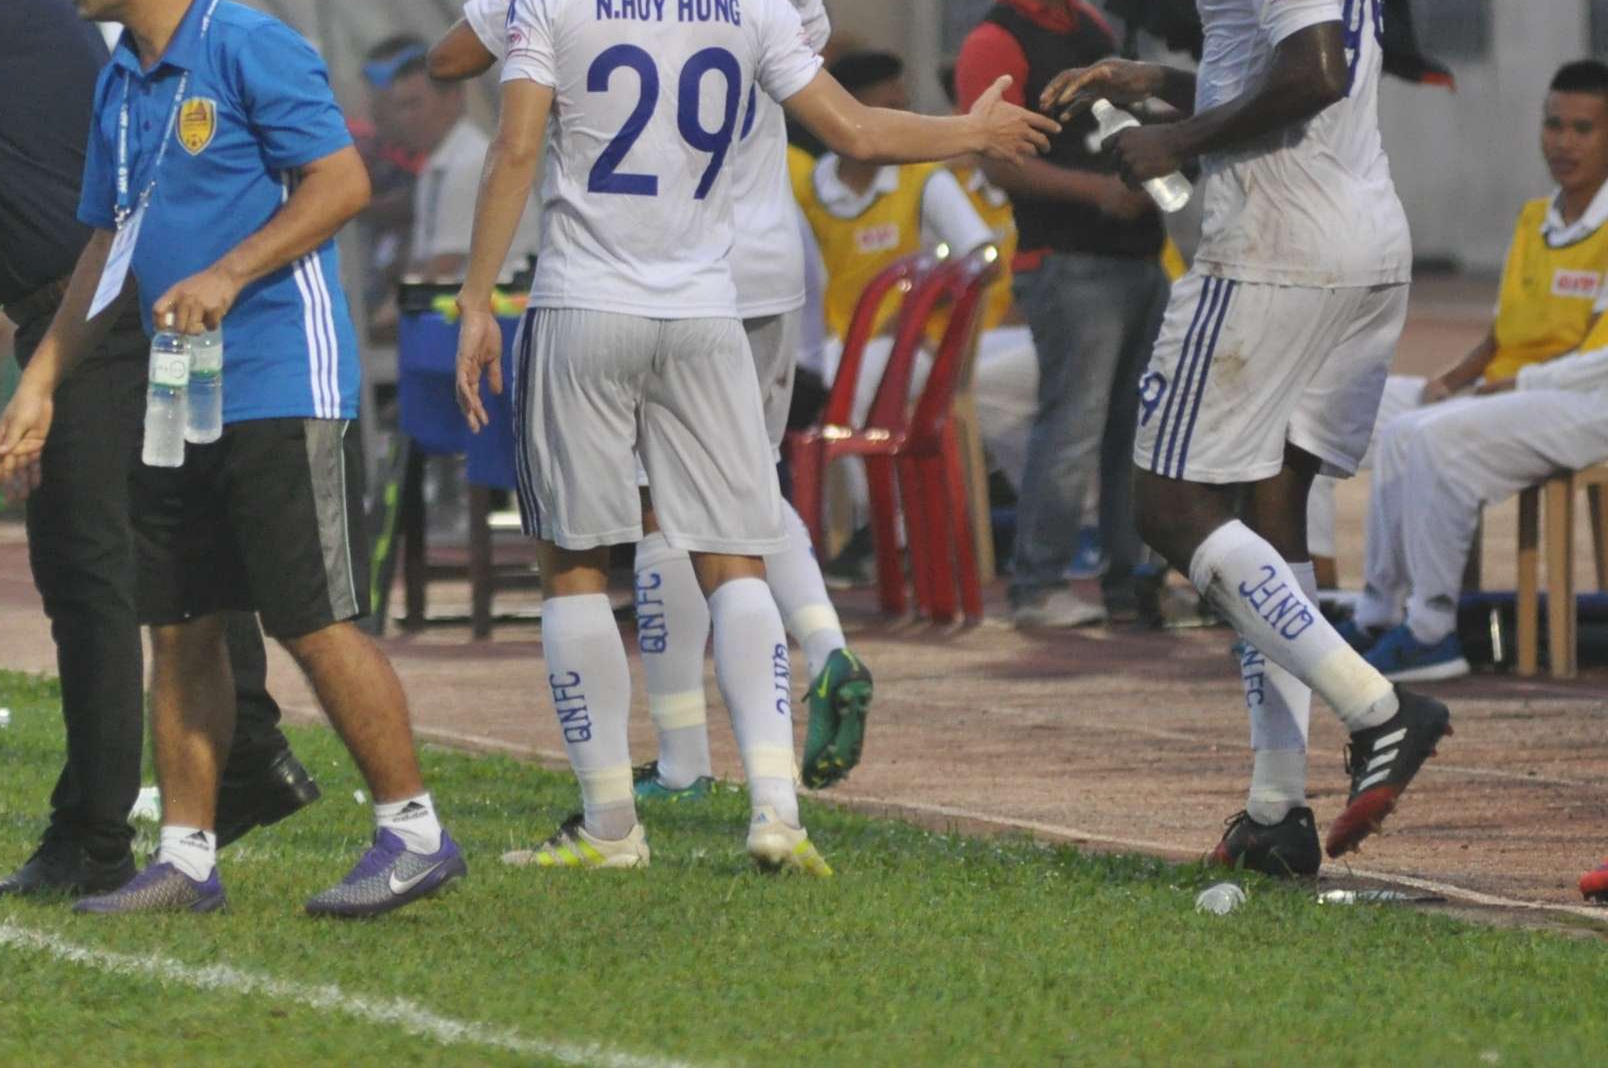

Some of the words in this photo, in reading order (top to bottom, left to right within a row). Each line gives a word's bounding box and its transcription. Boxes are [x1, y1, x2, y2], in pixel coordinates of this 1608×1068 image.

[586, 43, 742, 200] 29
[635, 572, 669, 654] QNFC
[1239, 564, 1315, 640] QNFC
[549, 670, 593, 744] QNFC
[1242, 649, 1265, 709] NFC
